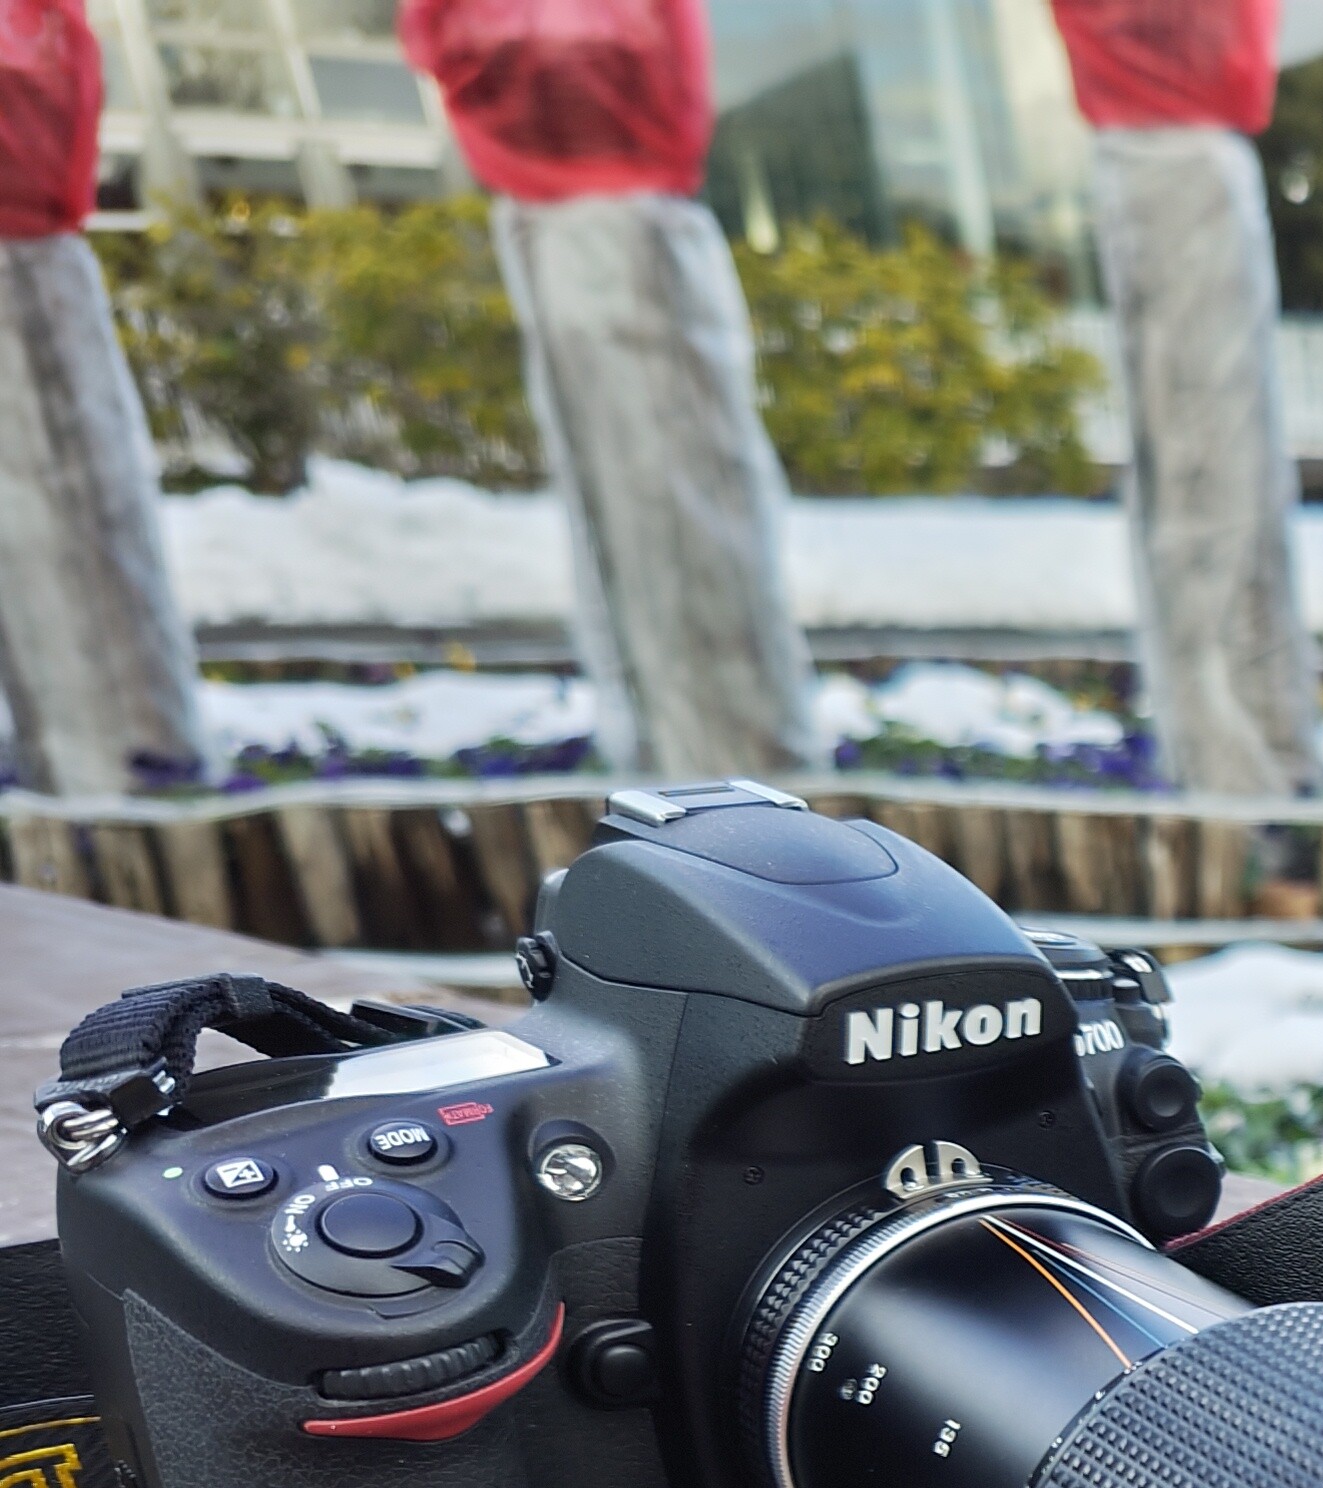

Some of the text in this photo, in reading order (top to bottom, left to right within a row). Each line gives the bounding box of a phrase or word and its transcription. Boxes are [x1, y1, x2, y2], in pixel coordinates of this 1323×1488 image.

[843, 998, 1042, 1065] Nikon
[374, 1127, 431, 1151] MODE
[324, 1176, 374, 1192] OFF
[284, 1194, 316, 1215] ON
[857, 1363, 889, 1405] 200
[932, 1418, 962, 1458] 135
